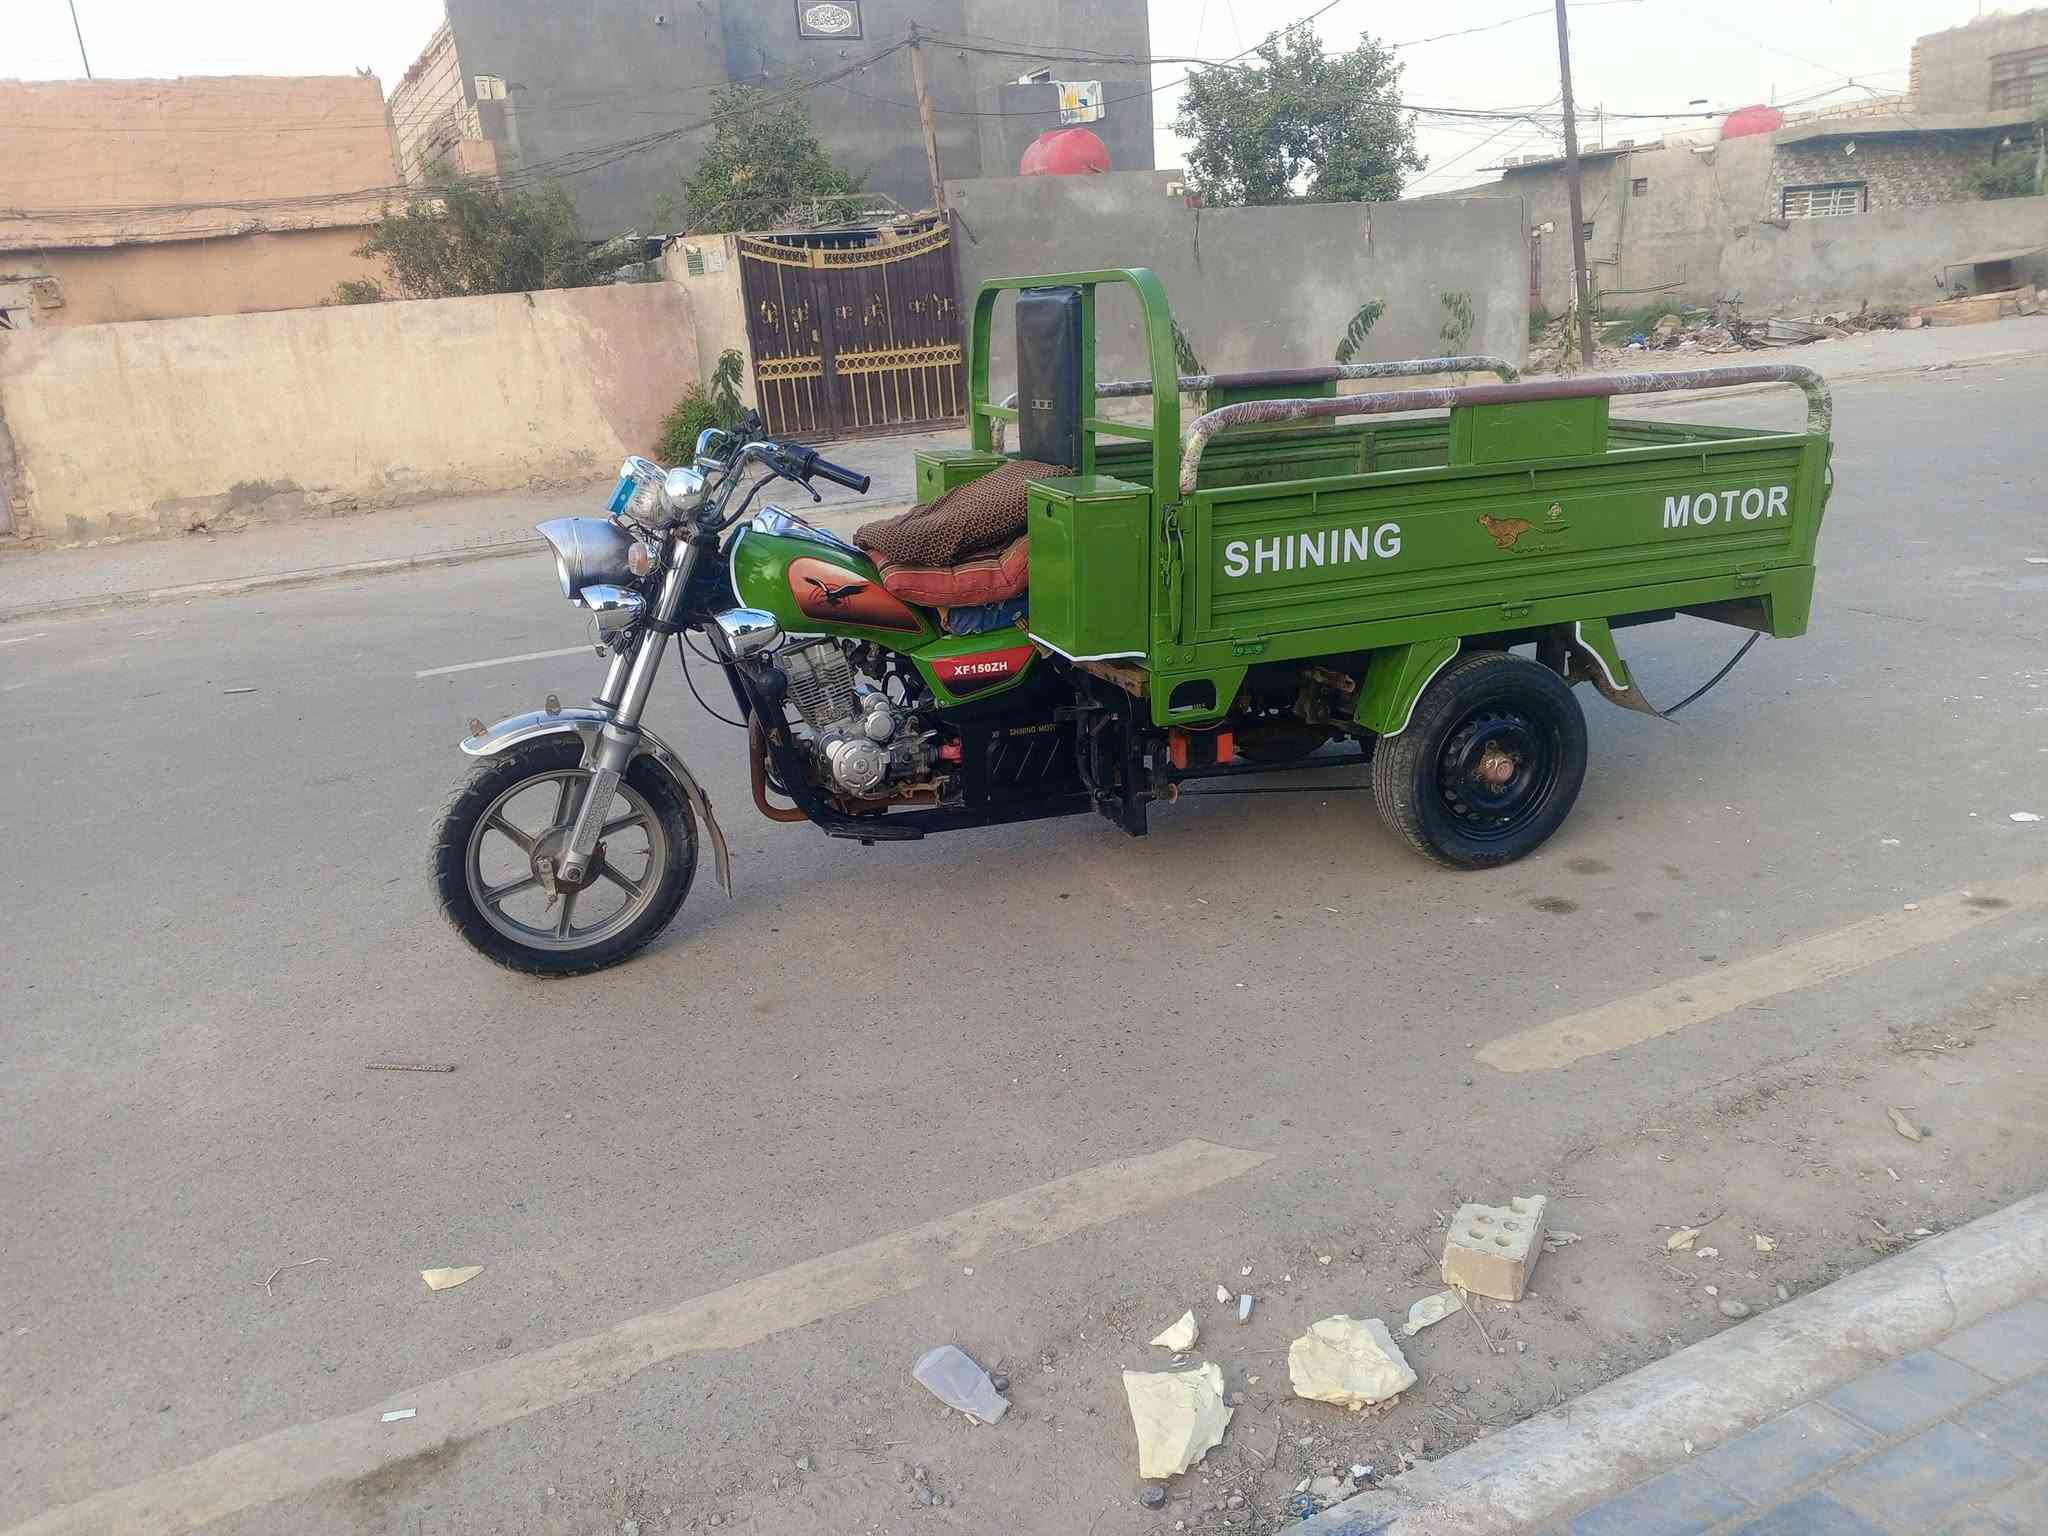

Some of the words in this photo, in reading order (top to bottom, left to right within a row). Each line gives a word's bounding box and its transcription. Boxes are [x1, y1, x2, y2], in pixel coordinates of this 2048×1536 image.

[1224, 522, 1401, 577] SHINING
[1663, 486, 1788, 529] MOTOR
[954, 661, 1008, 676] XF150ZH
